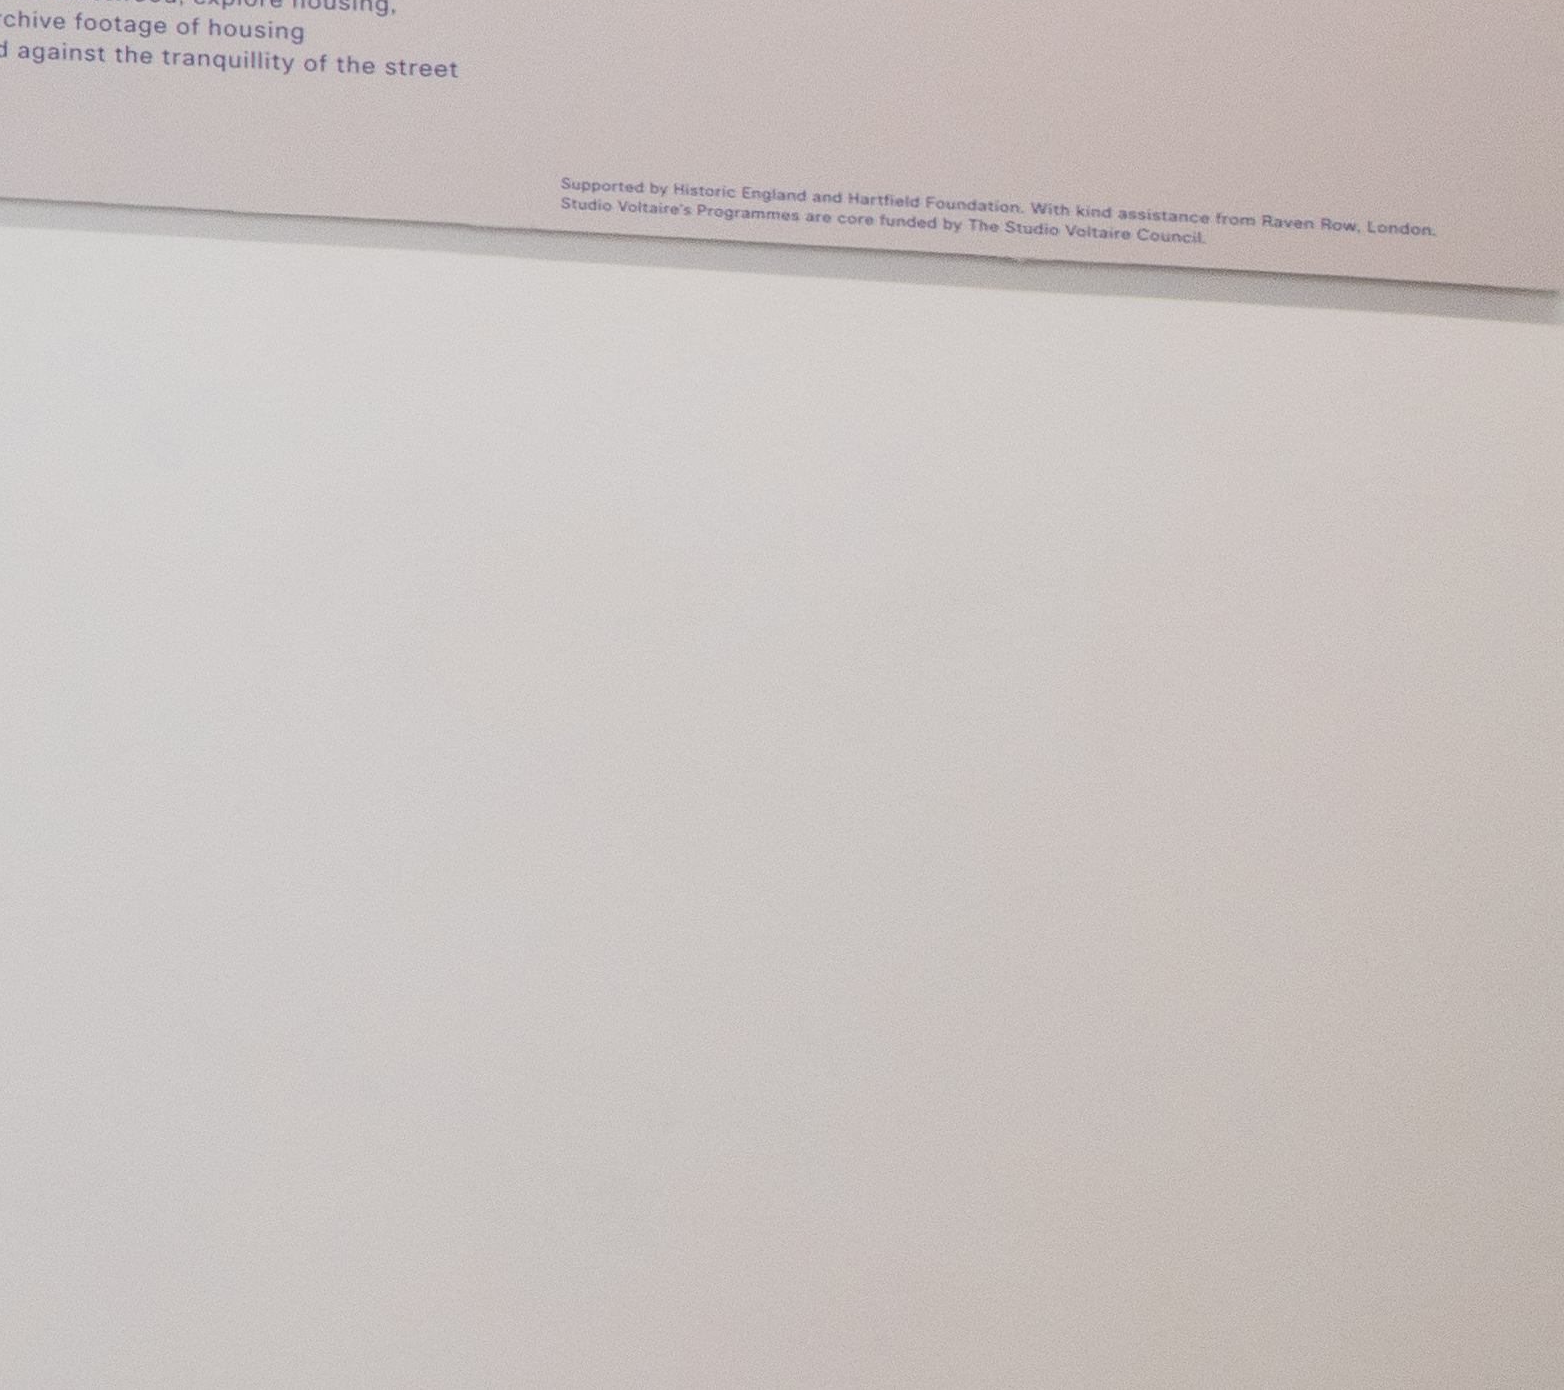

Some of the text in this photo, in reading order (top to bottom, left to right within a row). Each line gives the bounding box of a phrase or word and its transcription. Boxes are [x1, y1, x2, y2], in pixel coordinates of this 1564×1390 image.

[560, 176, 646, 194] Supported
[649, 181, 669, 198] by
[673, 182, 736, 199] Historic
[741, 185, 808, 204] England
[811, 191, 844, 205] and
[847, 192, 921, 209] Hartfield
[1030, 201, 1071, 217] With
[1075, 204, 1114, 220] kind
[1117, 209, 1211, 225] assistance
[1215, 211, 1258, 227] from
[1260, 213, 1316, 230] Raven
[560, 195, 613, 212] Studio
[696, 203, 801, 222] Programmes
[805, 212, 833, 224] are
[836, 214, 875, 226] core
[879, 213, 939, 230] funded
[942, 217, 963, 233] by
[968, 217, 1000, 233] The
[1004, 219, 1061, 236] Studio
[1064, 224, 1132, 240] Voltaire
